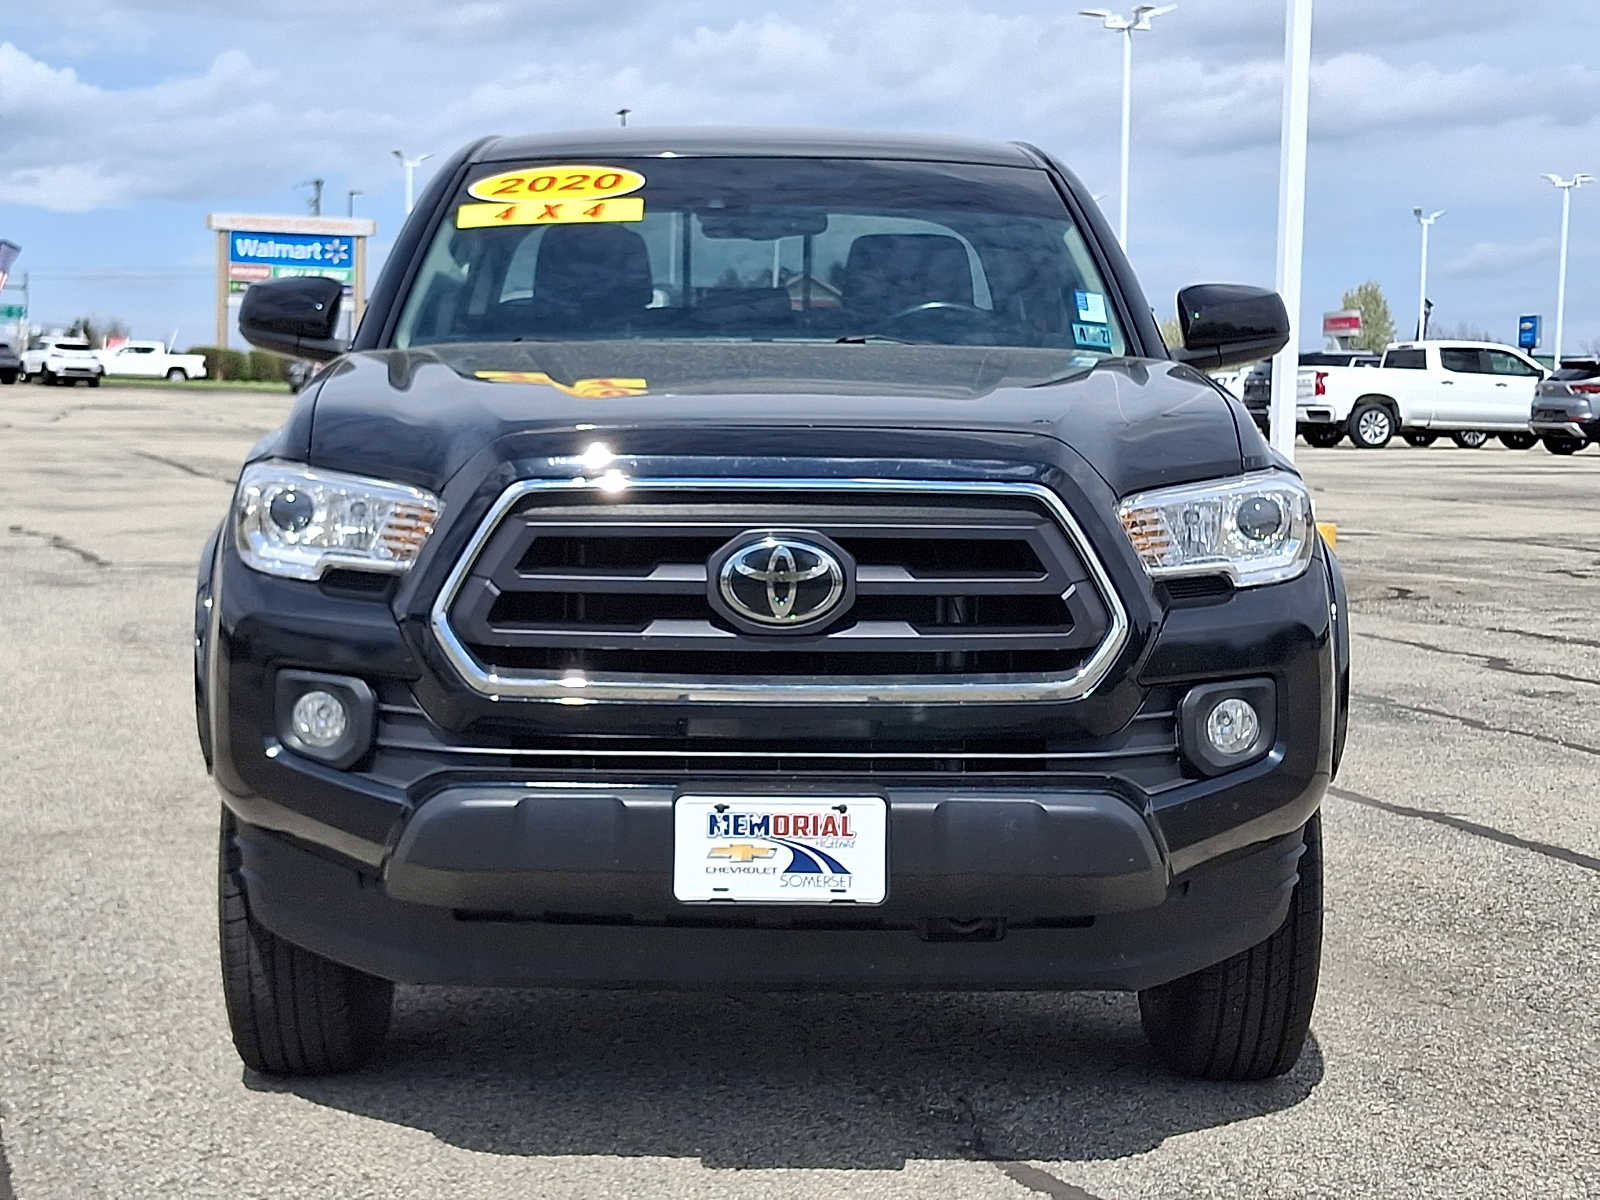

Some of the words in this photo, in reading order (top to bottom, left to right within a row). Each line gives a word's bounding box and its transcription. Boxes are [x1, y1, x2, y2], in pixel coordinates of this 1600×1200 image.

[492, 174, 624, 195] 2020
[495, 206, 516, 220] 4
[583, 203, 605, 217] 4
[236, 239, 323, 260] Walmart
[707, 813, 856, 838] MEMORIAL
[705, 866, 778, 875] CHEVROLET
[779, 875, 853, 889] SOMERSET
